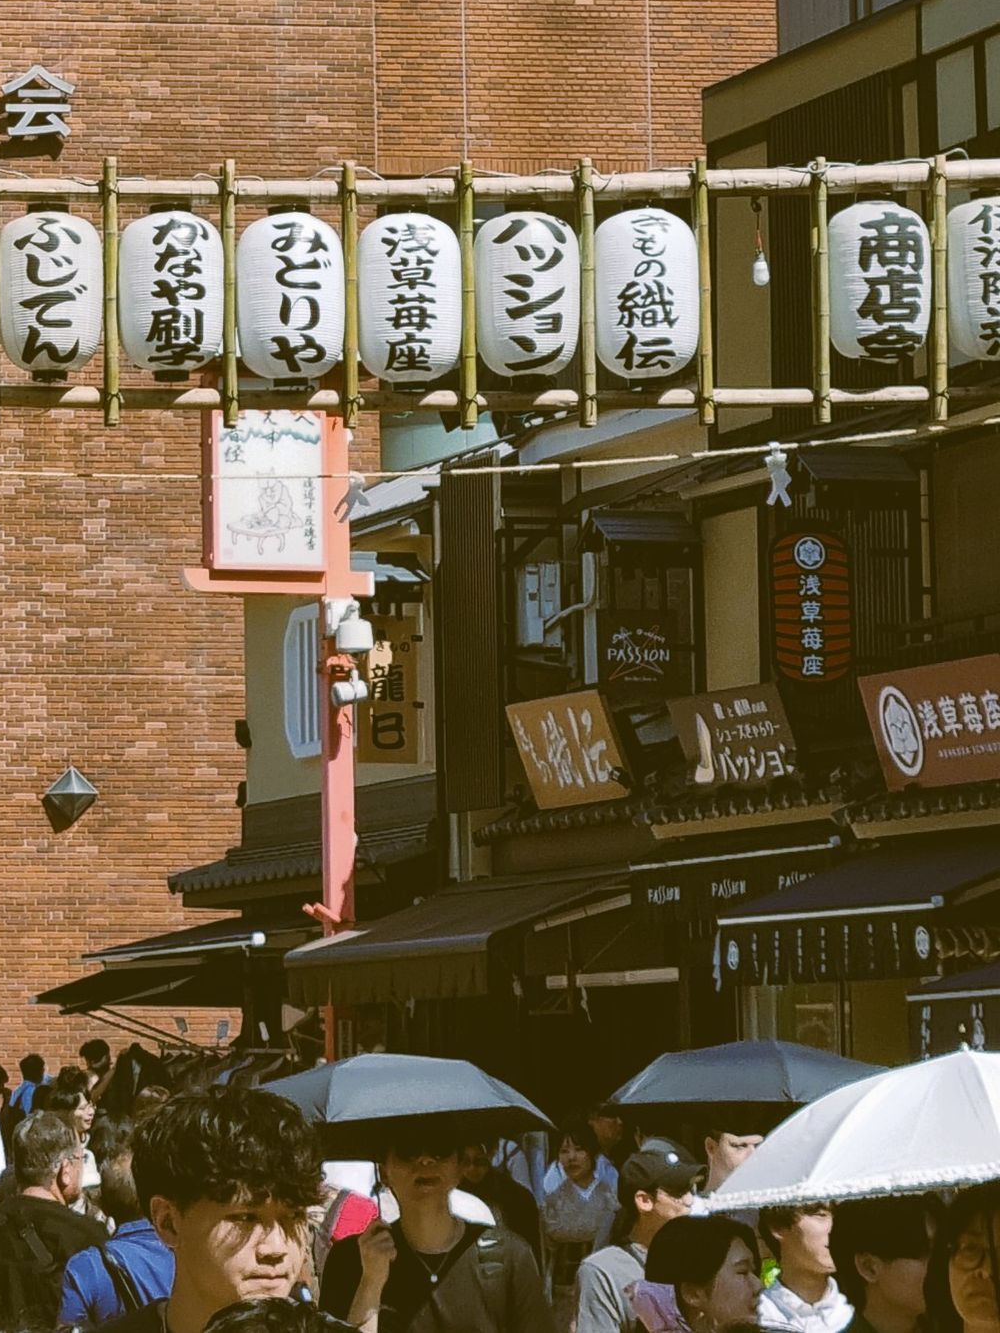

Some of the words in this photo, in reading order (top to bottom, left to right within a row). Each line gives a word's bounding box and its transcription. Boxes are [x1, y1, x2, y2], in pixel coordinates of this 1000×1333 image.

[13, 217, 88, 364] ふじでん
[145, 219, 209, 366] かなや刷子
[271, 222, 331, 373] みどりや
[381, 223, 439, 372] 浅草苺座
[615, 214, 679, 370] きもの織伝
[856, 212, 924, 358] 商店会
[606, 646, 669, 663] PASSION
[799, 574, 824, 675] 浅草苺座
